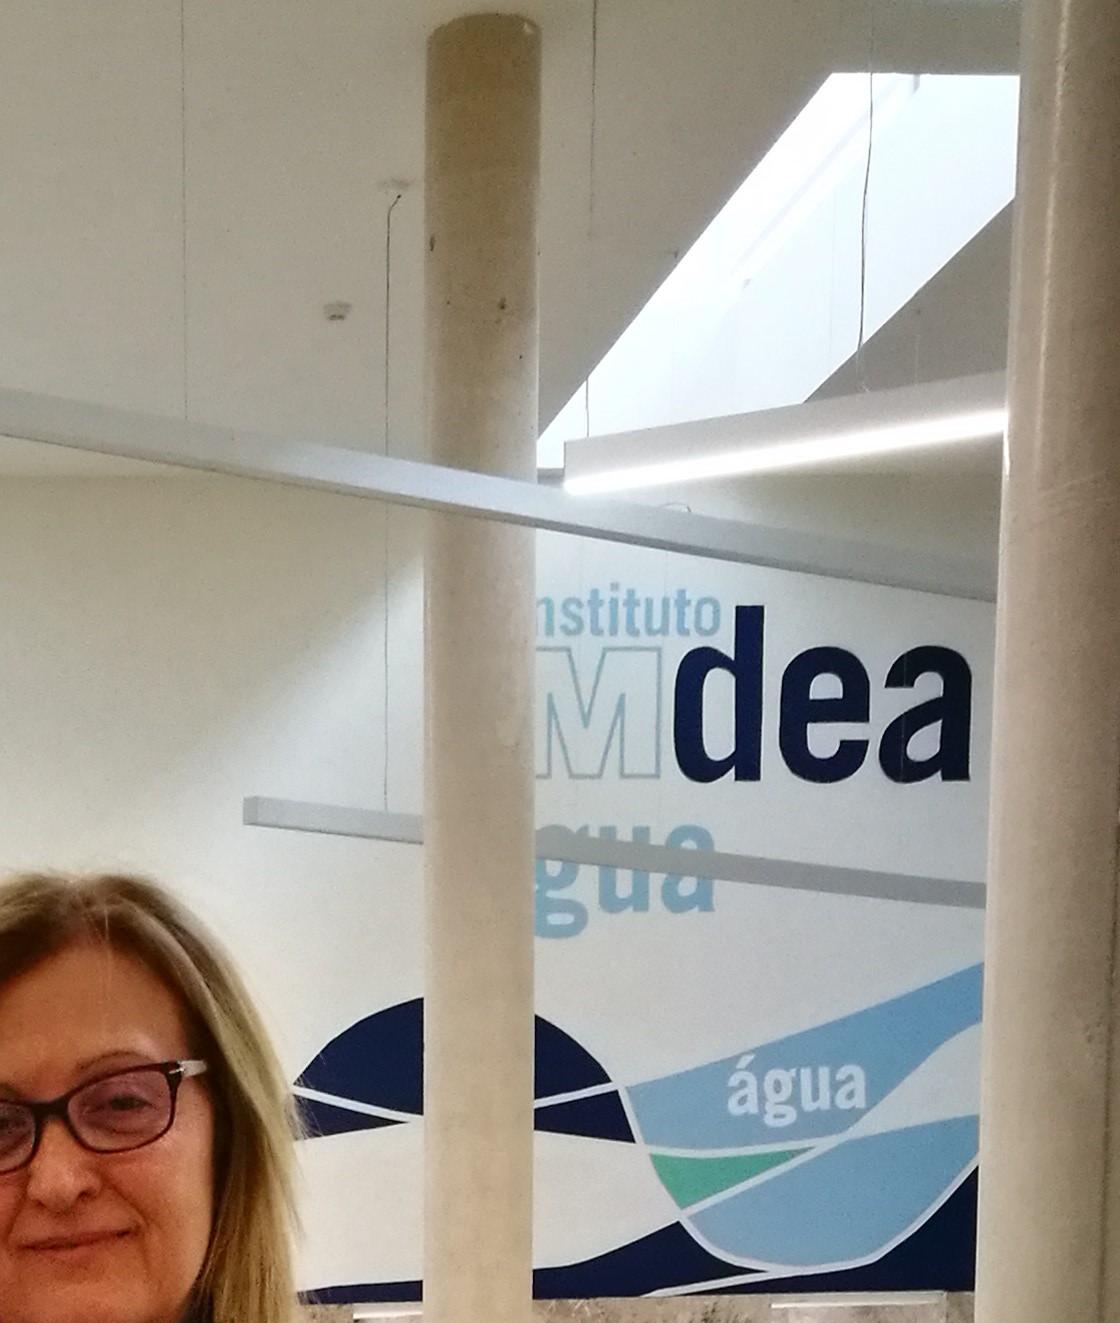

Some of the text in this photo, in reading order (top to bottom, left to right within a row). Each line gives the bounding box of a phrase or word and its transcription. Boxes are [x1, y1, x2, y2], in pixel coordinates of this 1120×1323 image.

[534, 581, 721, 638] nstituto
[534, 605, 974, 784] Mdea
[534, 821, 717, 940] gua
[726, 1053, 867, 1128] água
